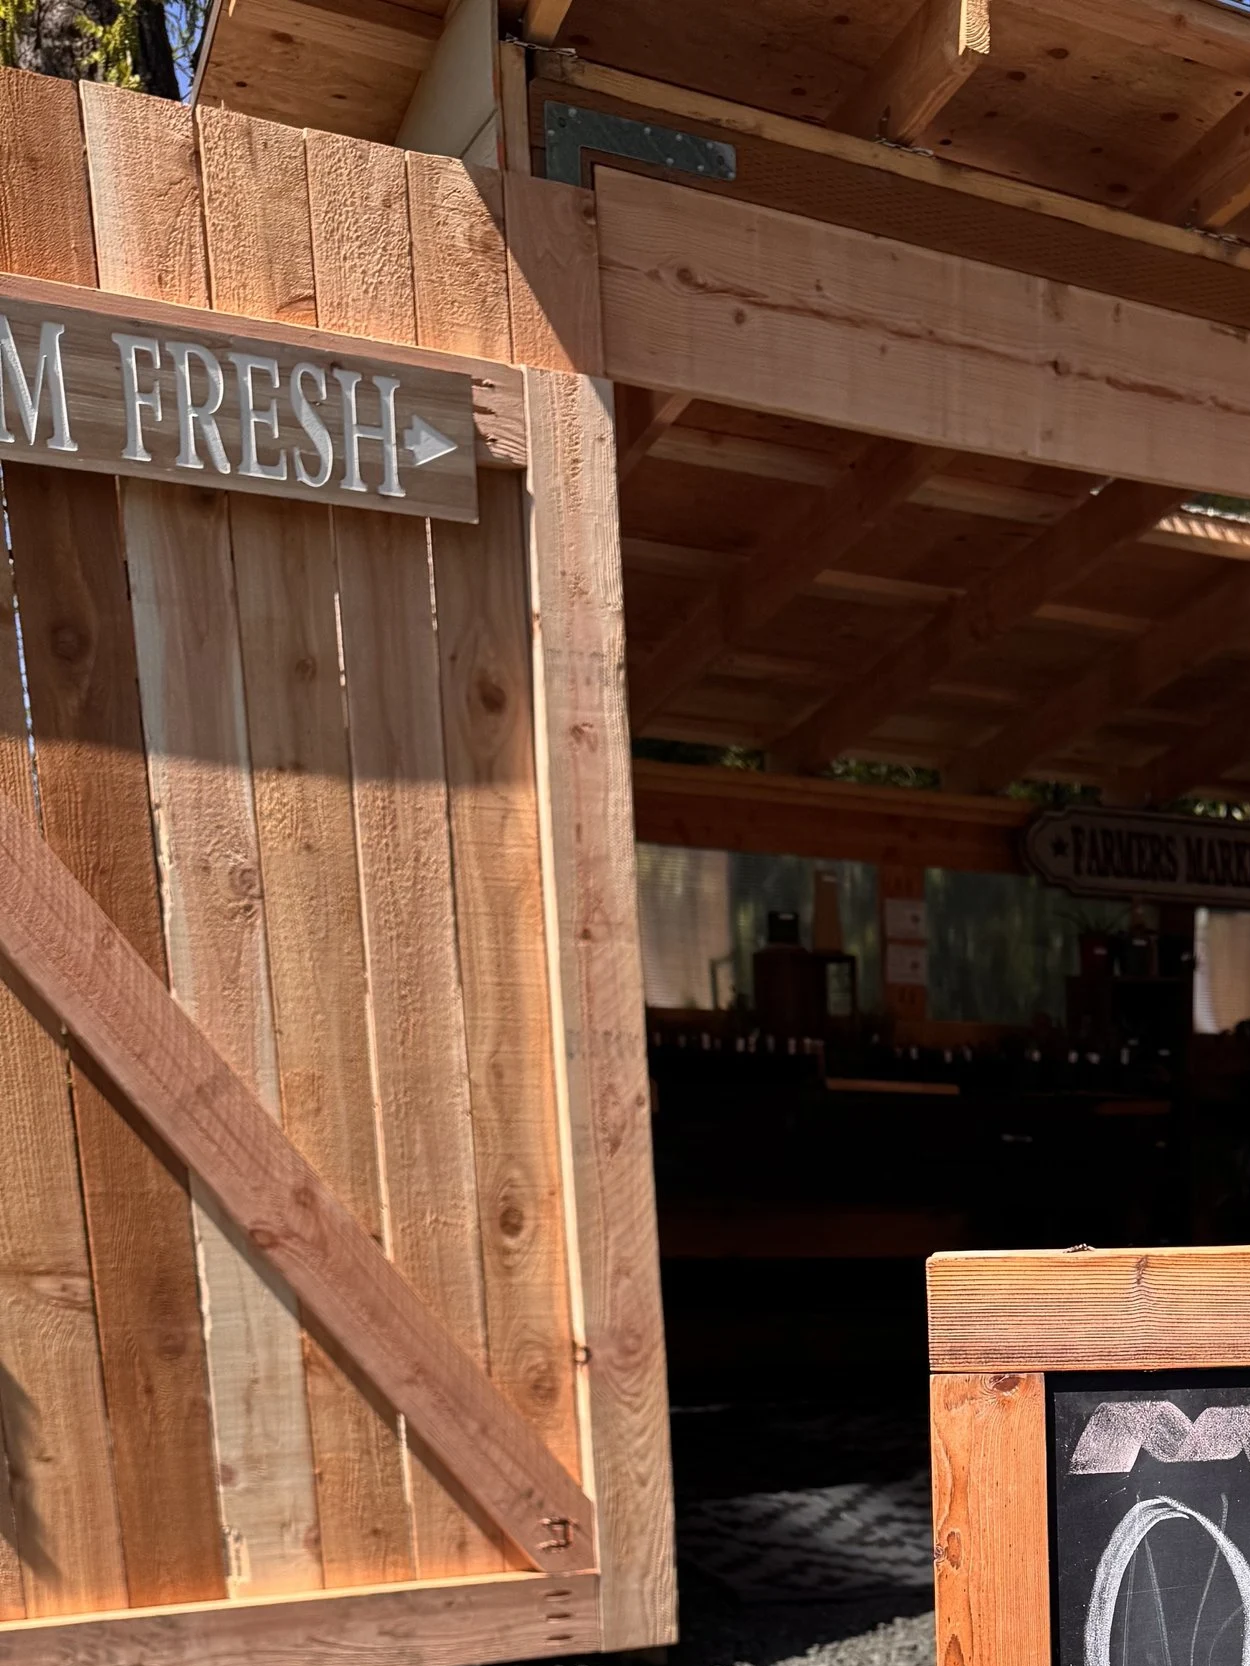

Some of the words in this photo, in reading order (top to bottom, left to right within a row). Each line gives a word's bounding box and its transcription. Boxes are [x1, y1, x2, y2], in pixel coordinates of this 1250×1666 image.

[0, 314, 79, 453] M
[111, 331, 407, 499] FRESH
[1070, 825, 1178, 880] FARMERS
